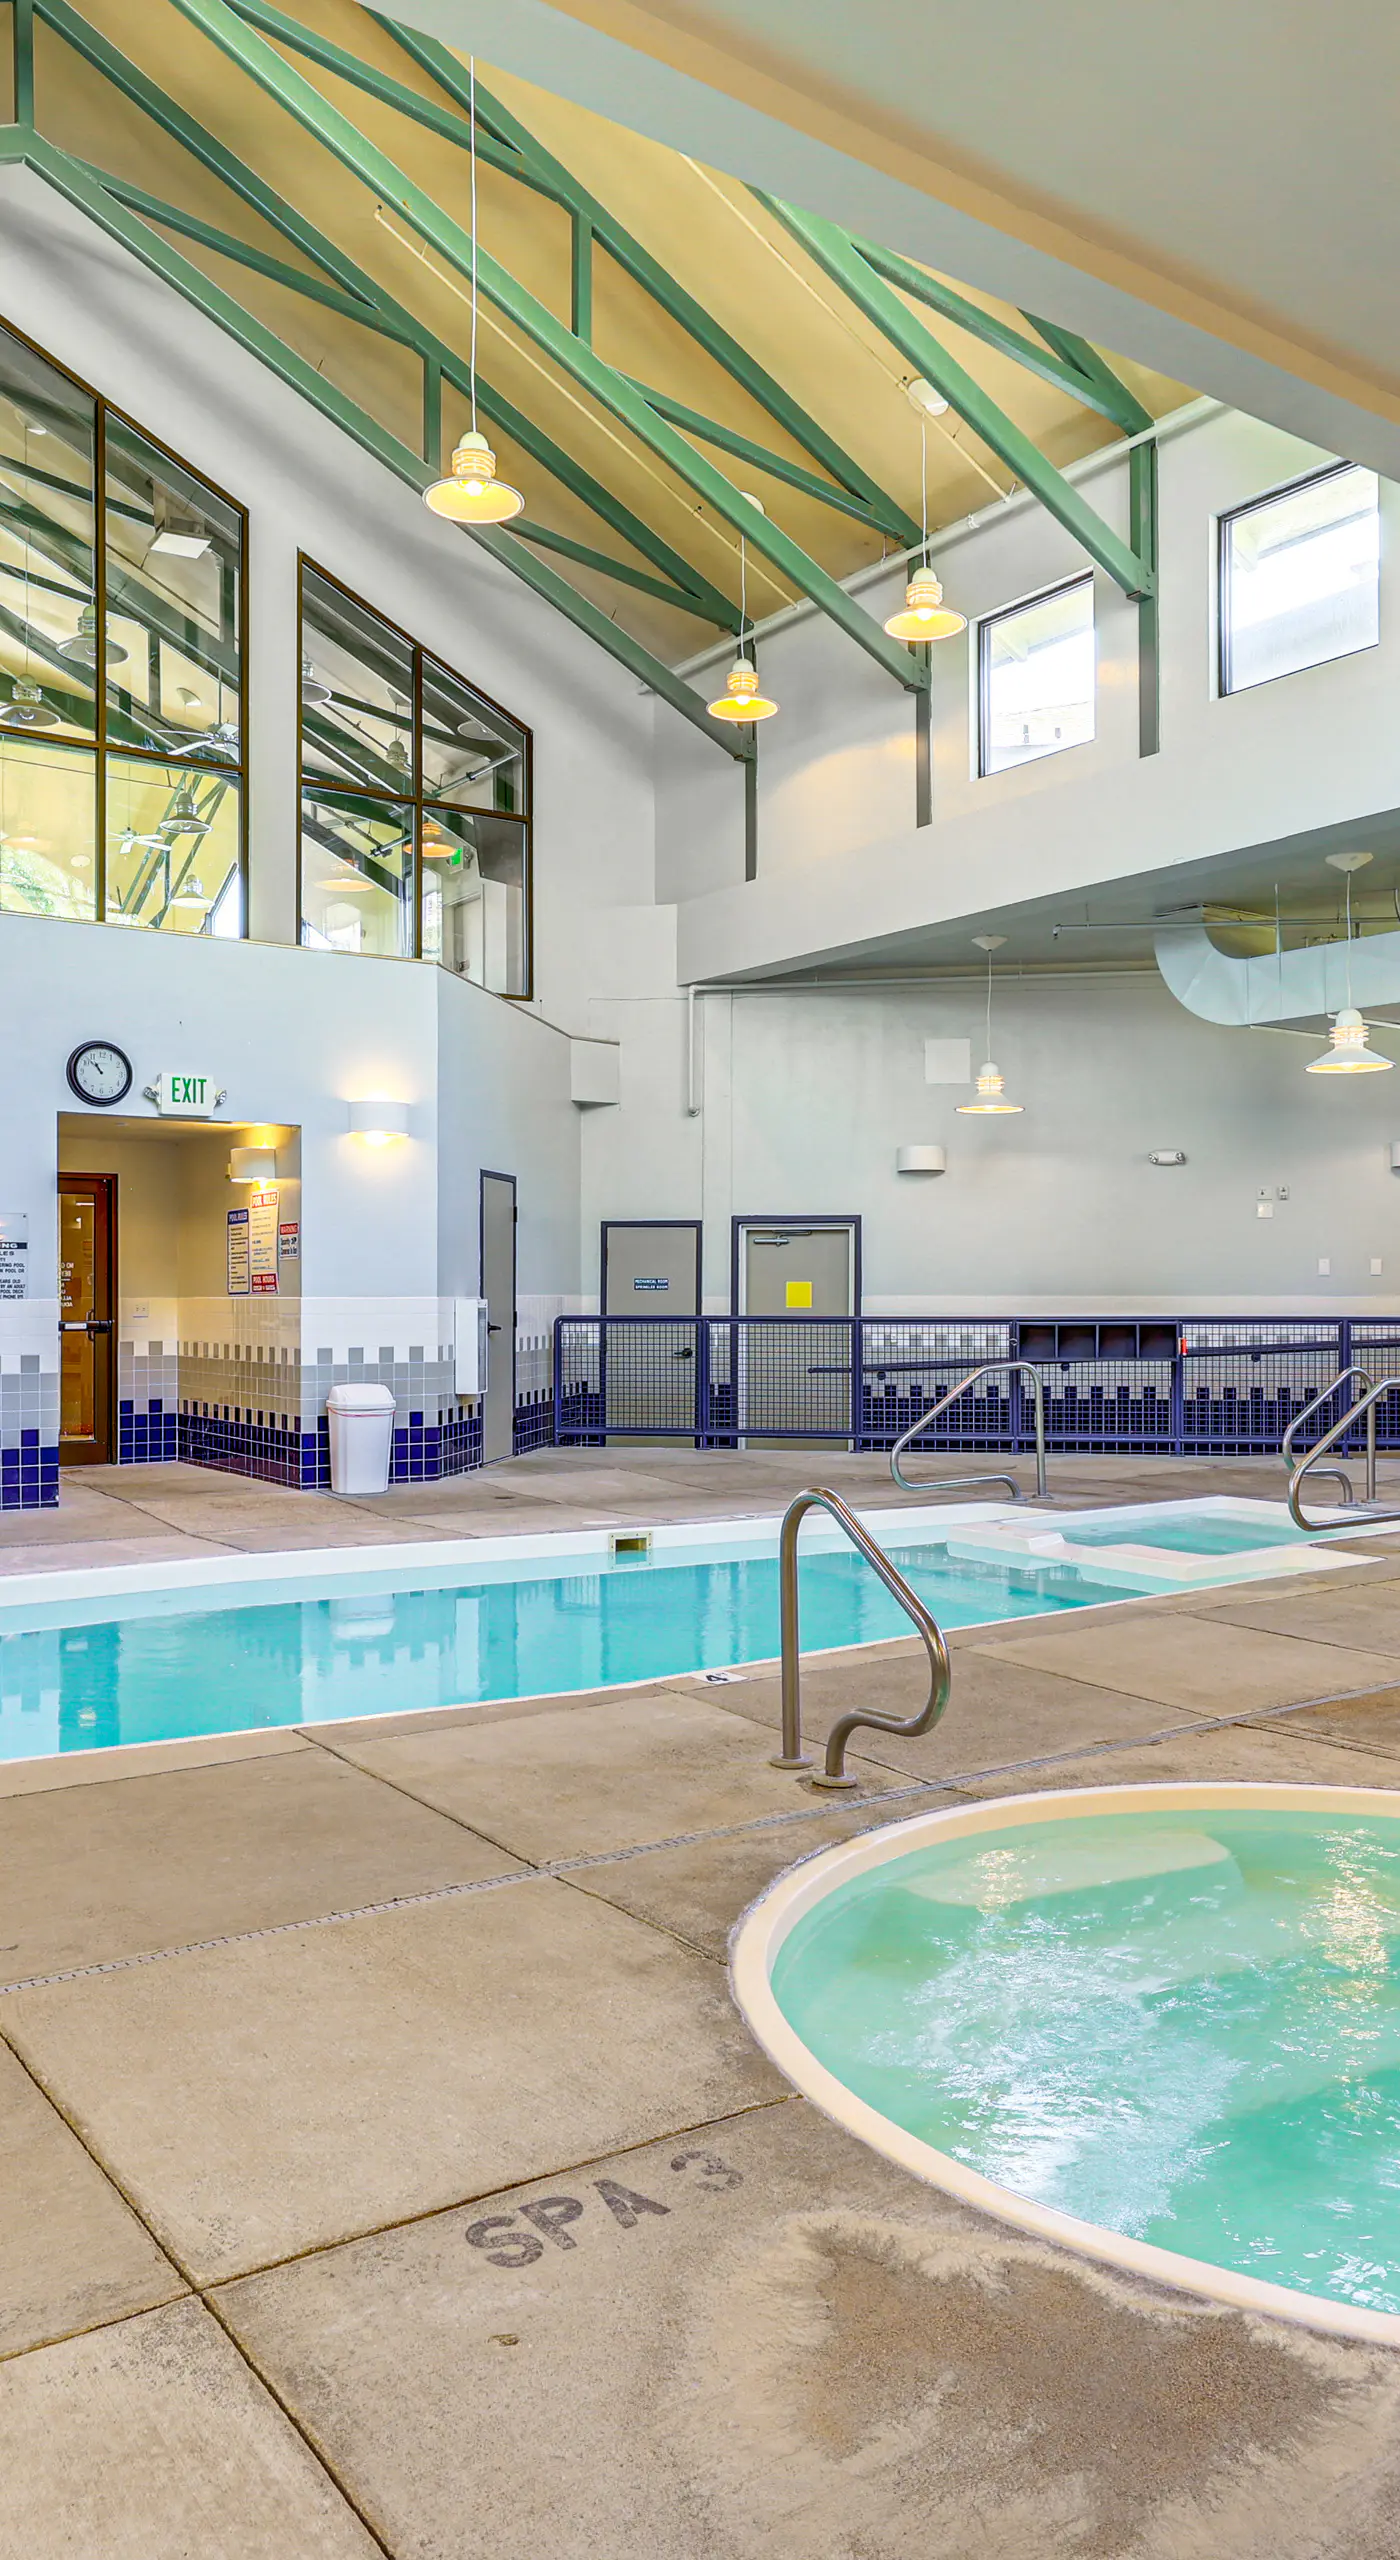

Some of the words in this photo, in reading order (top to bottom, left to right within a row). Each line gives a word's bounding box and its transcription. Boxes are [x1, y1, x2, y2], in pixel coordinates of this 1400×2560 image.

[171, 1076, 207, 1104] EXIT
[465, 2179, 671, 2268] SPA
[670, 2151, 744, 2193] 3
